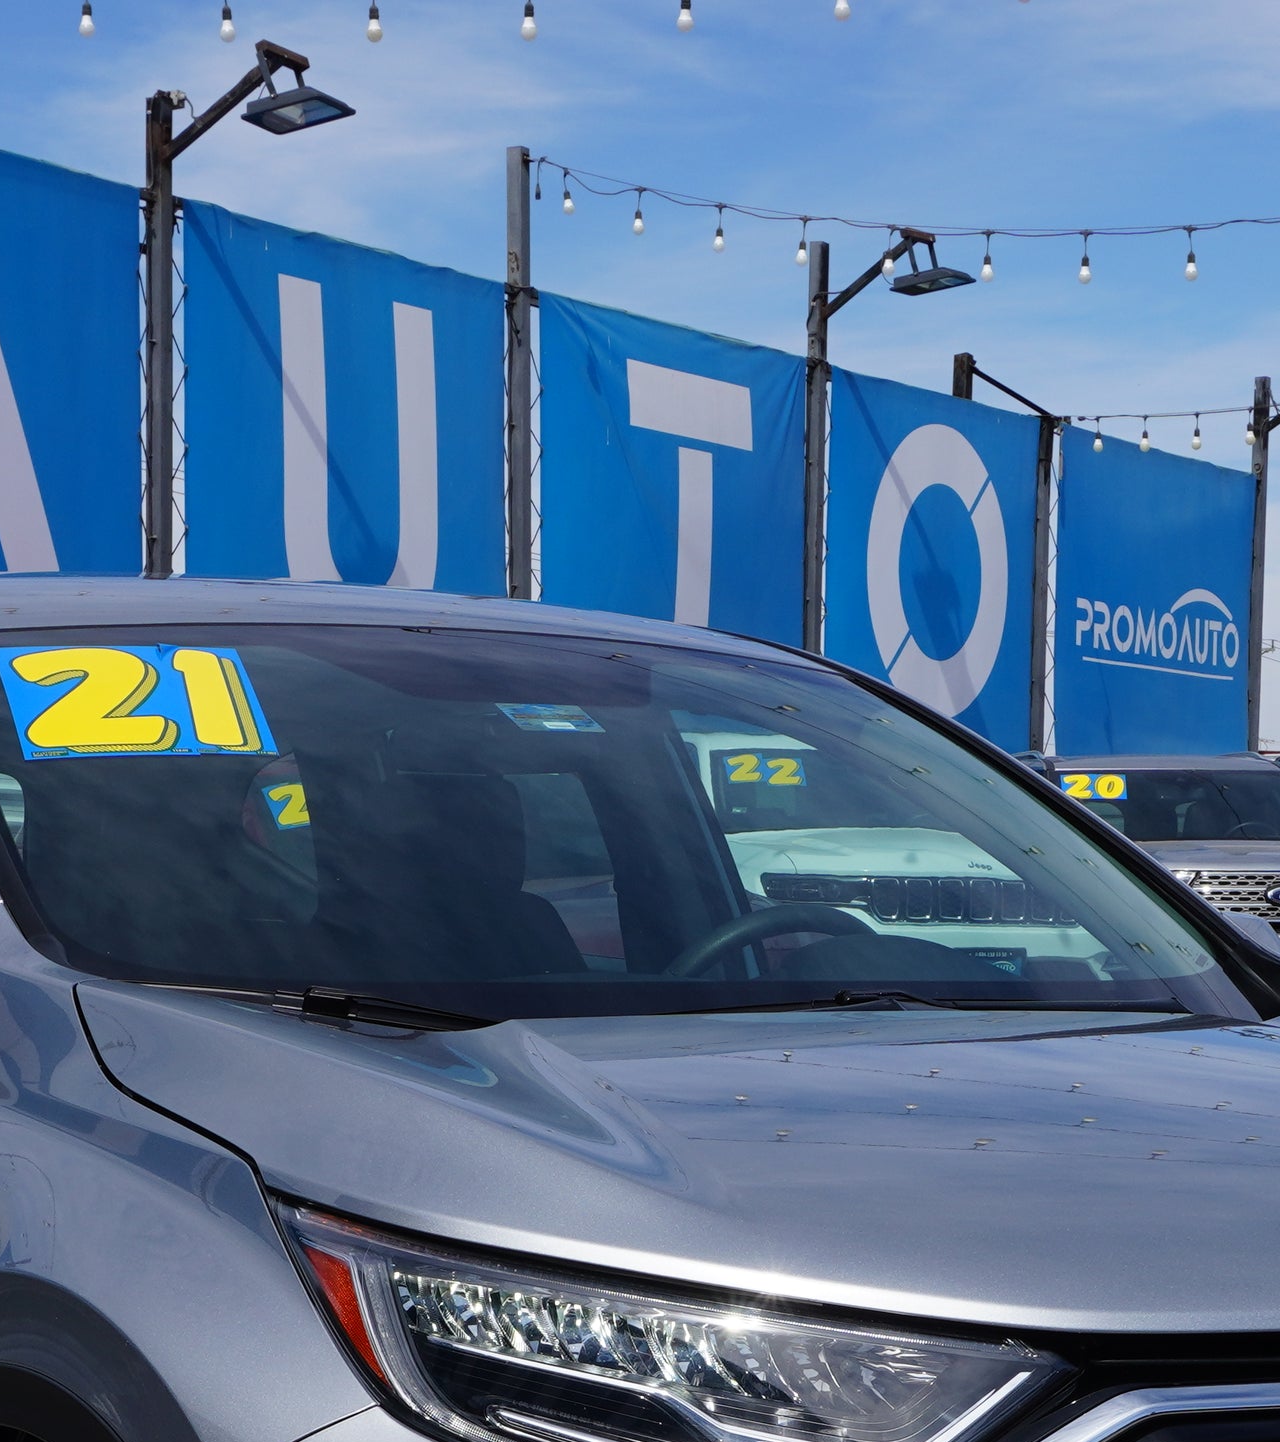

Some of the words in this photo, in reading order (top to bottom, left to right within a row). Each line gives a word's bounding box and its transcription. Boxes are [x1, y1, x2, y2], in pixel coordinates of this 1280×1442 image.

[1075, 597, 1240, 669] PROMOAUTO
[10, 646, 262, 753] 21
[727, 753, 802, 785] 22
[1063, 773, 1125, 799] 20
[967, 861, 993, 871] Jeep
